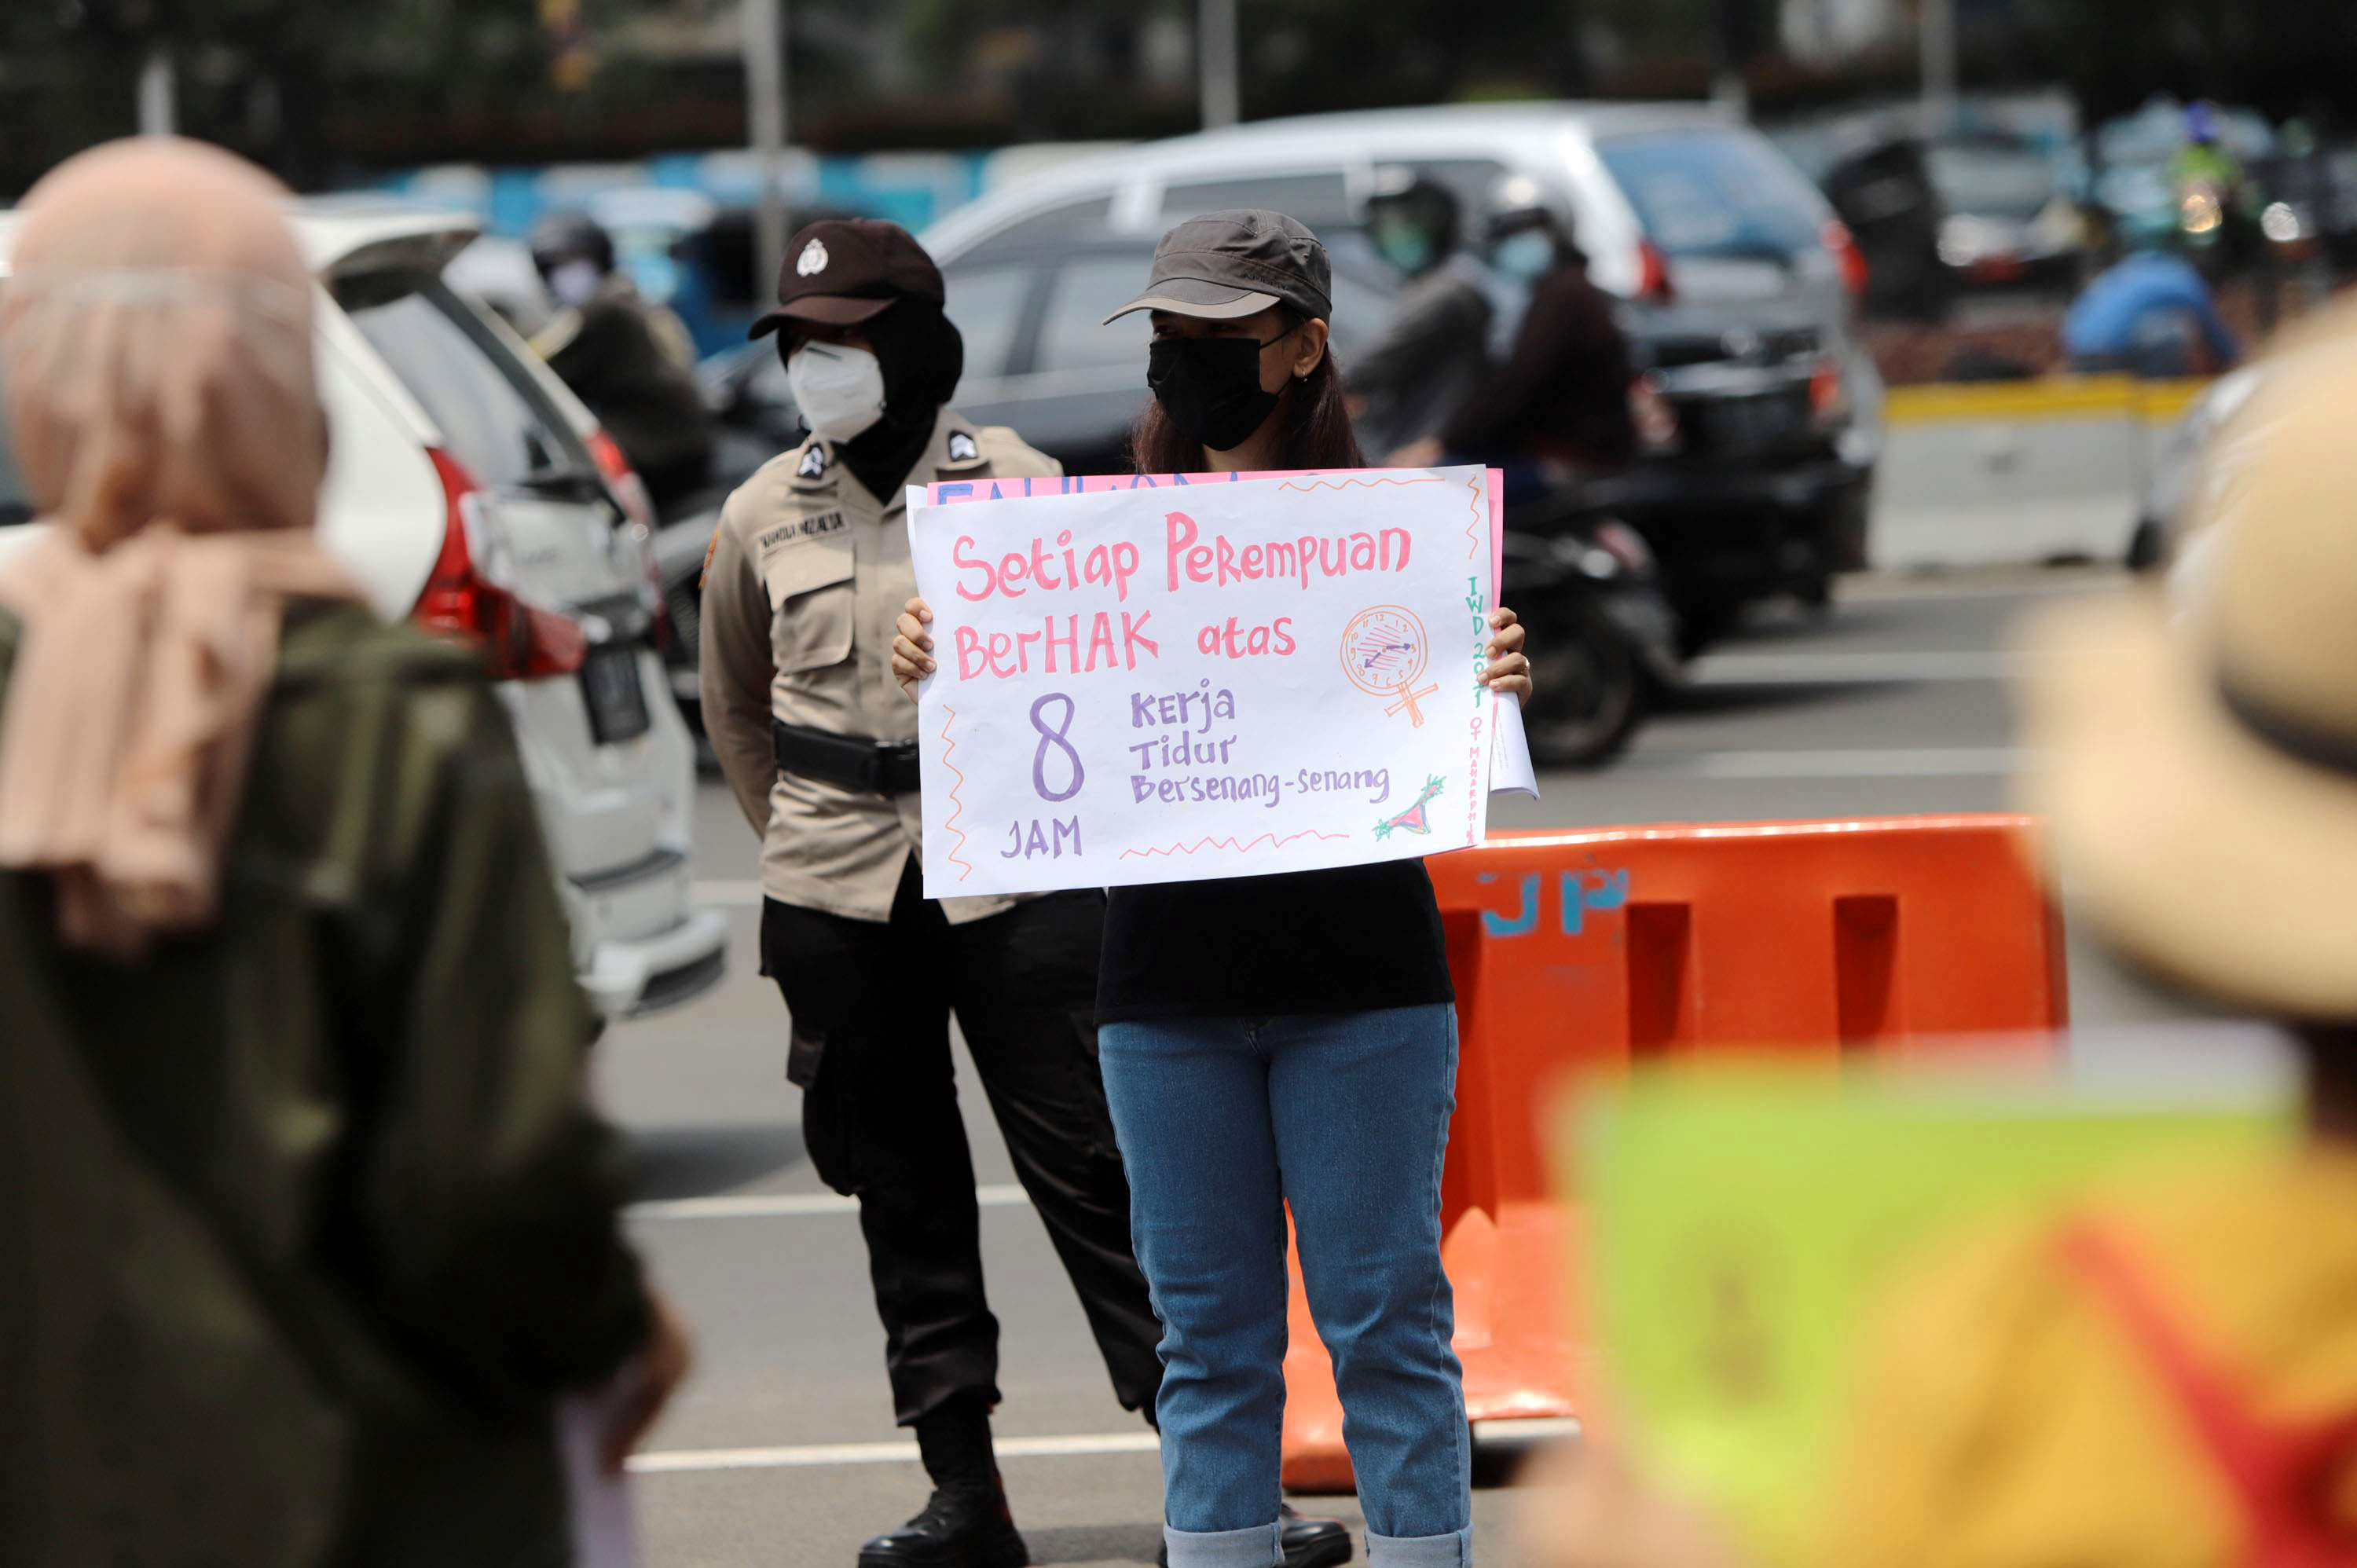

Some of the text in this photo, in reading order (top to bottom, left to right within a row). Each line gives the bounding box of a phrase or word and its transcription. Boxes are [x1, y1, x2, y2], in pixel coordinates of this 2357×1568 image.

[953, 530, 1139, 602] Setiap
[1465, 576, 1484, 636] IWD
[955, 610, 1296, 680] BerHAK atas
[1030, 693, 1085, 802] 8
[1128, 730, 1237, 771] Tidur
[999, 814, 1083, 859] JAM
